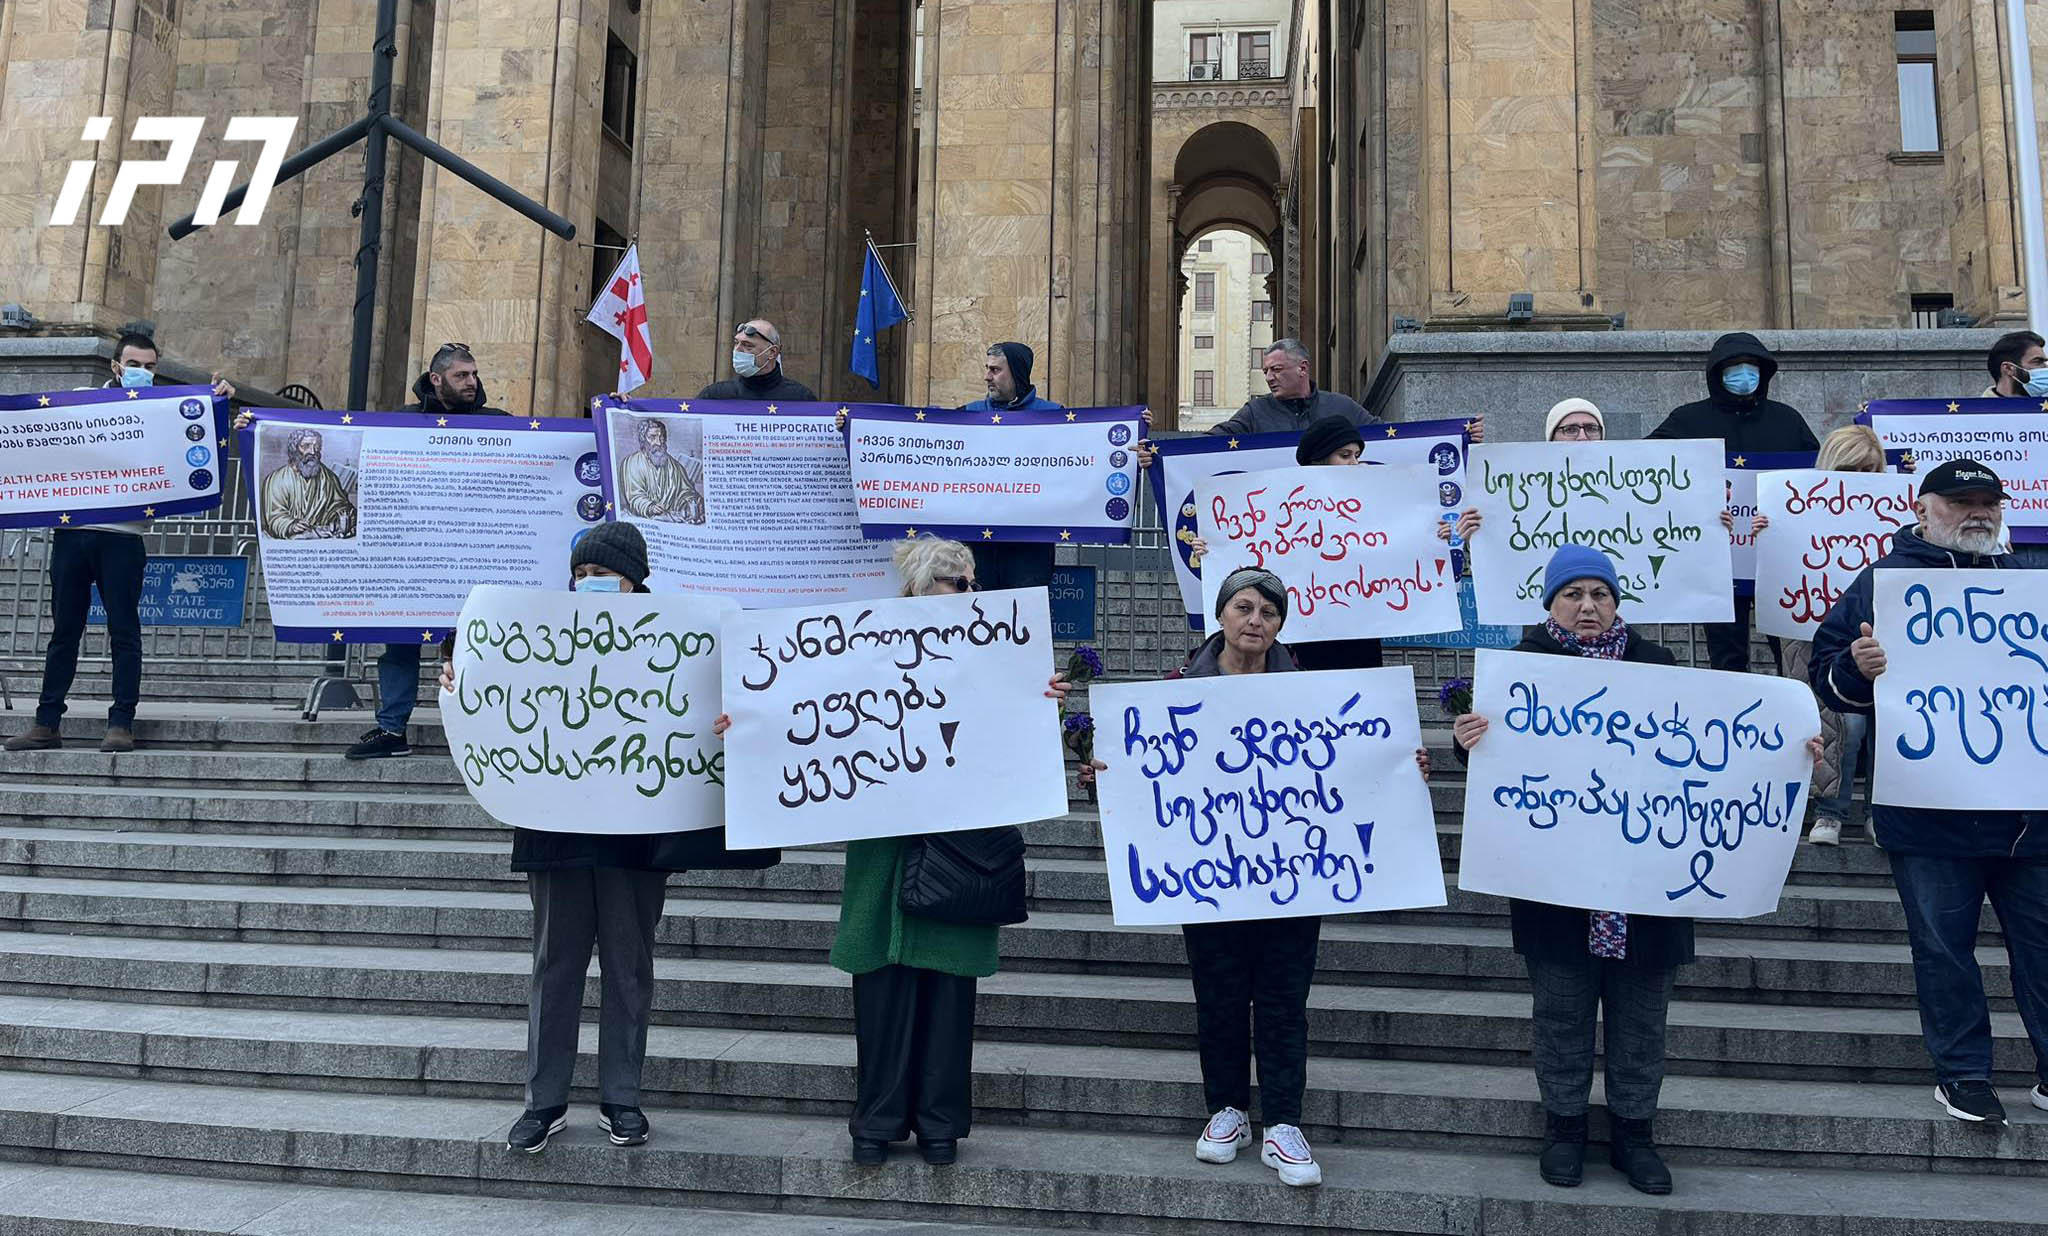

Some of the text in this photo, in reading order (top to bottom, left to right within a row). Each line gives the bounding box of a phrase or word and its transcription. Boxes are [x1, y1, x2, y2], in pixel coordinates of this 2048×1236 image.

[13, 420, 83, 434] ჯანდაცვის
[85, 414, 145, 429] სისტემა,
[26, 434, 86, 448] წამლები
[88, 433, 107, 443] არ
[110, 429, 145, 441] აქვთ
[428, 435, 512, 447] ექიმის ფიცი
[735, 423, 834, 432] THE HIPPOCRATIC
[1889, 430, 2014, 444] საქართველოს
[859, 452, 1096, 468] პერსონალიზირებულ მედიცინას!
[862, 435, 895, 447] ჩვენ
[898, 436, 965, 451] ვითხოვთ
[18, 487, 49, 500] HAVE
[52, 484, 110, 498] MEDICINE
[113, 483, 129, 494] TO
[131, 479, 176, 493] CRAVE.
[36, 472, 68, 483] CARE
[70, 469, 118, 481] SYSTEM
[120, 465, 165, 478] WHERE
[861, 479, 1041, 495] WE DEMAND PERSONALIZED
[1483, 454, 1692, 513] სიცოცხლისთვის
[859, 497, 925, 510] MEDICINE!
[1211, 484, 1363, 541] ჩვენ ერთად
[1244, 519, 1390, 569] ვიბრძვით
[1509, 509, 1645, 560] ბრძოლის
[167, 594, 206, 607] STATE
[172, 607, 224, 620] SERVICE
[465, 608, 716, 674] დაგვეხმარეთ
[741, 597, 1032, 692] ჯანმრთელობის
[1904, 583, 2048, 673] მინდ
[458, 663, 690, 735] სიცოცხლის
[786, 672, 948, 747] უფლება
[1122, 691, 1392, 780] ჩვენ ვდგავართ
[1504, 681, 1785, 773] მხარდაჭერა
[1152, 765, 1345, 847] სიცოცხლის
[1493, 768, 1802, 851] ონკოპაციენტებს!
